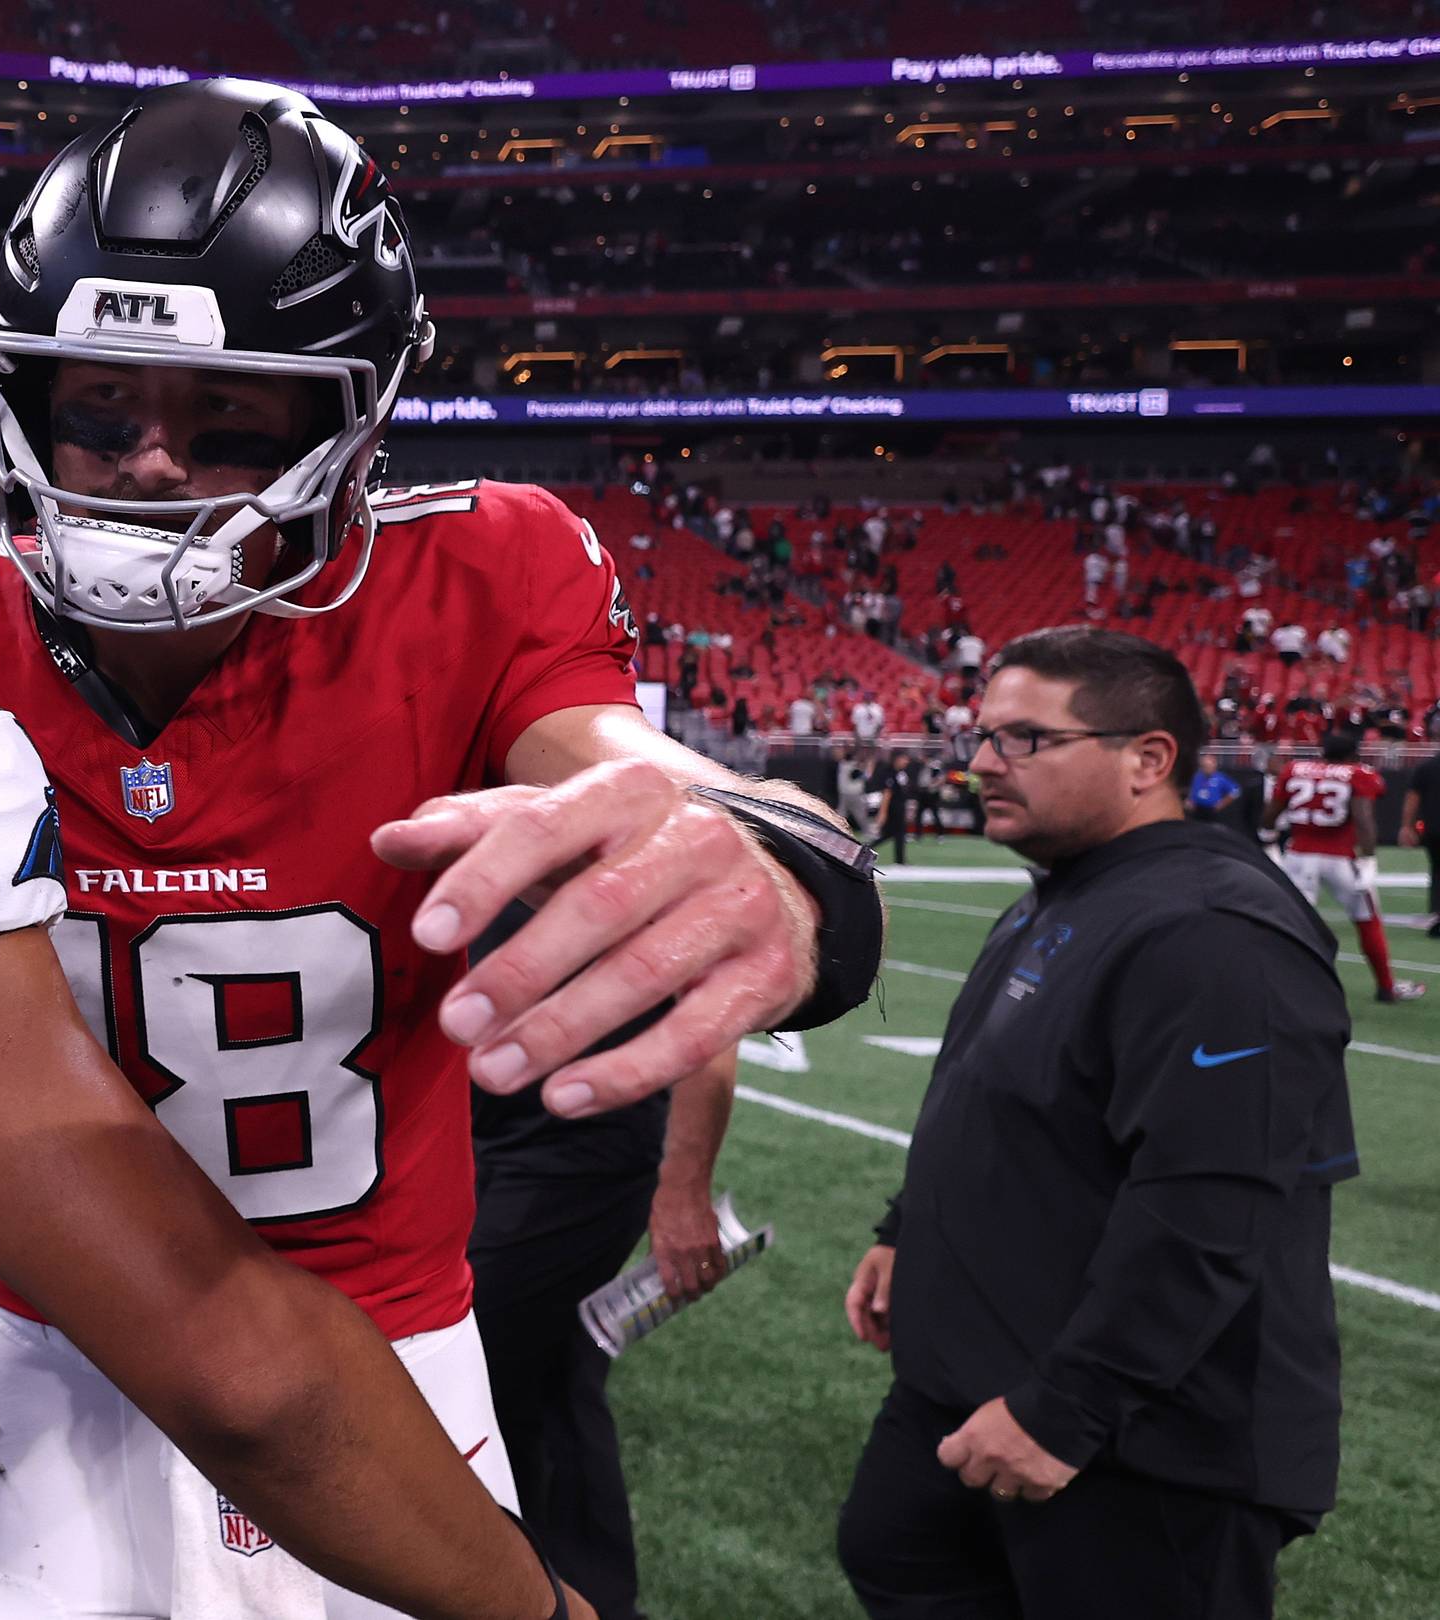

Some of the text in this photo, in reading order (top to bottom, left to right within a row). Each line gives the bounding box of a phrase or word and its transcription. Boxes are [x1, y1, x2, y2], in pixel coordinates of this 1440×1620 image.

[50, 56, 88, 83] Pay
[89, 61, 136, 84] with
[892, 58, 936, 83] Pay
[937, 54, 992, 79] with
[93, 289, 178, 328] ATL
[391, 396, 429, 421] ith
[130, 786, 167, 812] NFL
[1284, 777, 1353, 828] 23
[74, 868, 268, 893] FALCONS
[224, 1515, 270, 1549] NFL
